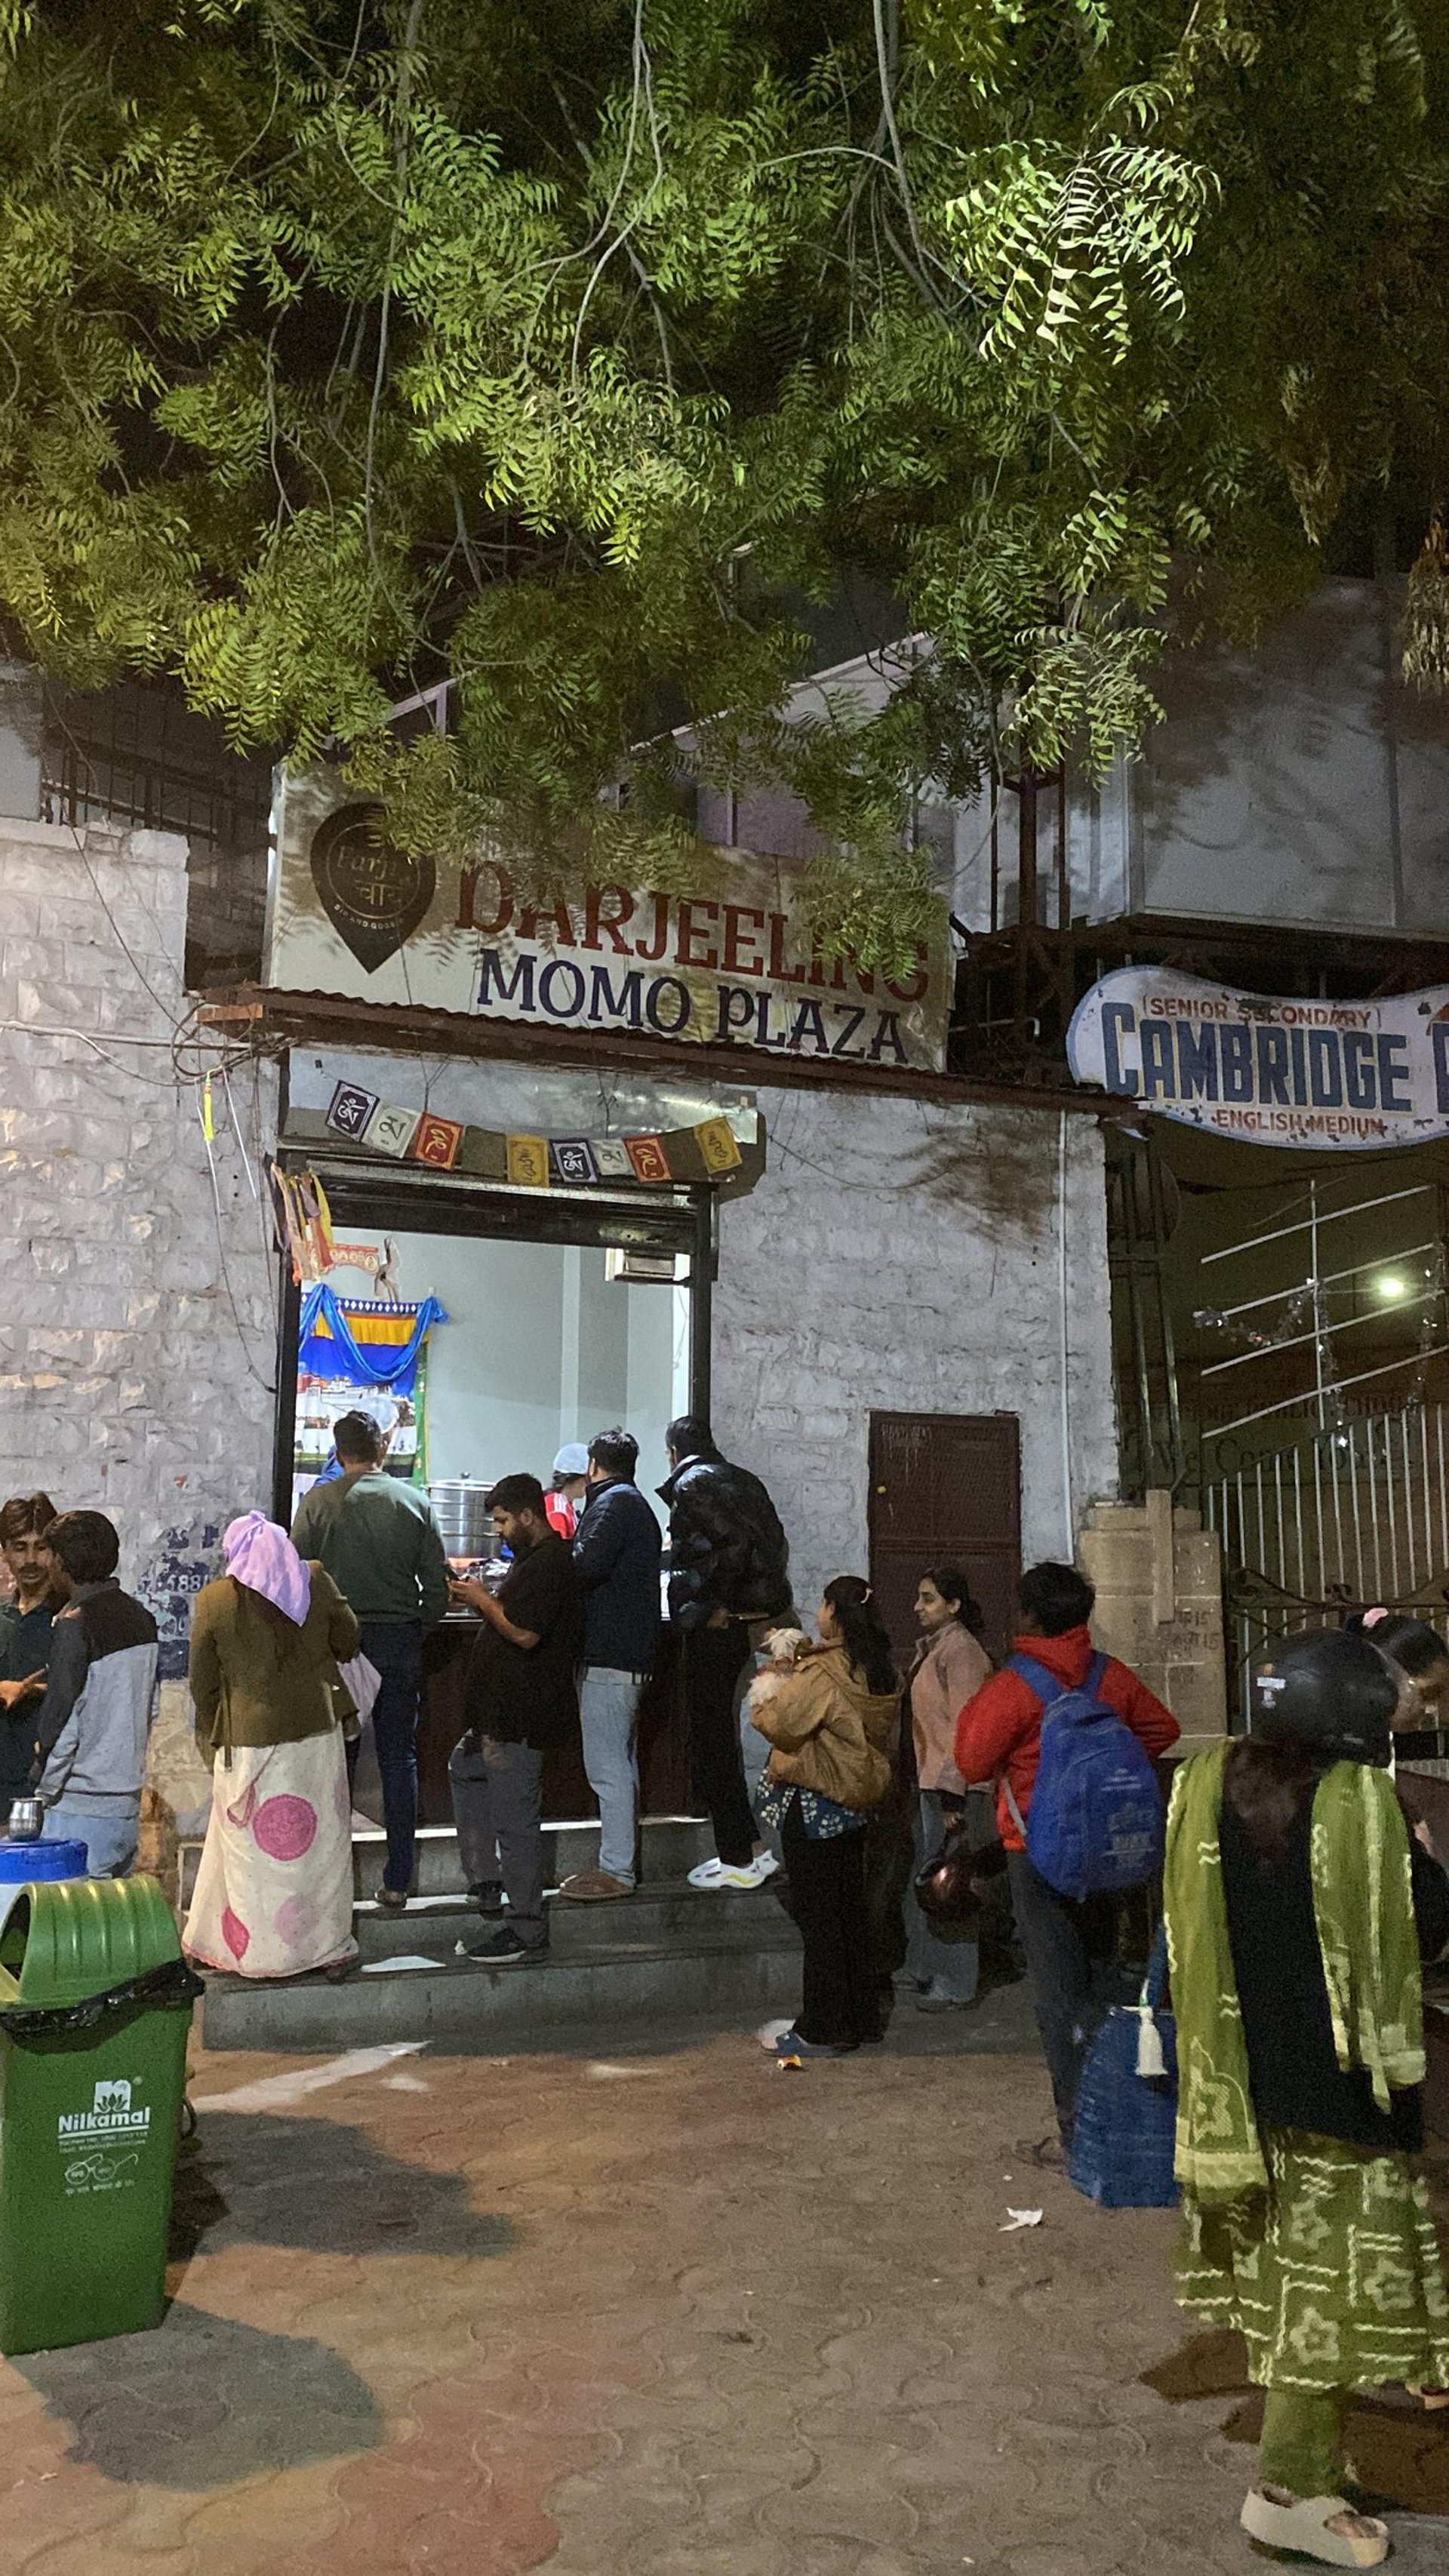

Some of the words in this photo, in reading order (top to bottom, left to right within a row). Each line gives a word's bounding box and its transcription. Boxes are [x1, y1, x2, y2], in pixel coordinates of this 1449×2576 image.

[478, 947, 690, 1033] MOMO
[715, 985, 907, 1063] PLAZA
[1101, 1002, 1411, 1112] CAMBRIDGE
[58, 2107, 151, 2133] Nilkamal
